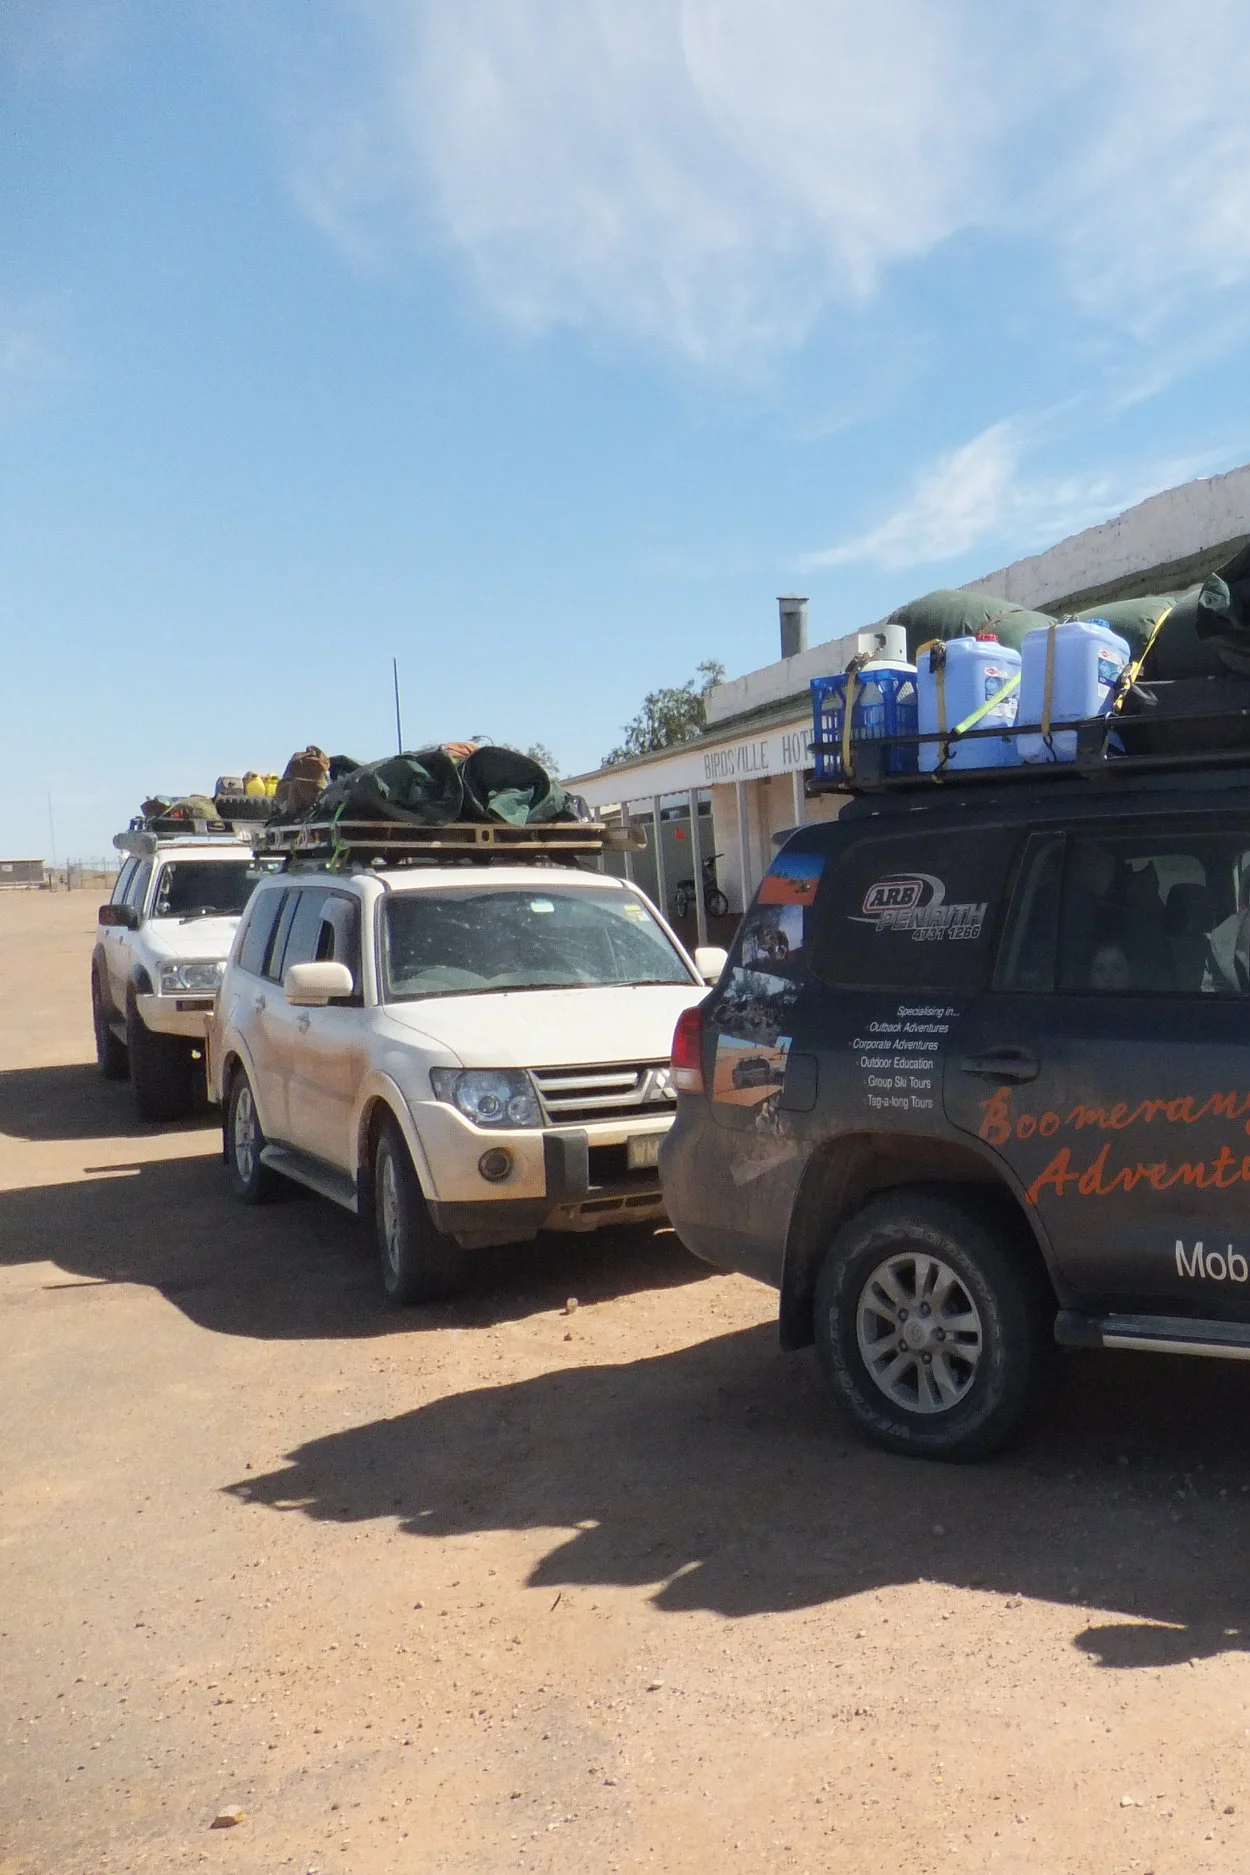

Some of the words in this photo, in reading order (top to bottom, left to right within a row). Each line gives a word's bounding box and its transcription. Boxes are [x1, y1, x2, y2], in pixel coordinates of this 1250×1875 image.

[703, 741, 769, 780] BIRDSVILLE
[782, 728, 814, 765] HOT
[870, 887, 915, 906] ARB
[875, 902, 988, 931] PENRITH
[949, 925, 981, 939] 1266
[897, 1006, 944, 1018] Specialising
[869, 1022, 901, 1032] Outback
[903, 1022, 949, 1033] Adventures
[852, 1038, 892, 1051] Corporate
[892, 1039, 939, 1051] Adventures
[860, 1056, 892, 1068] Outdoor
[893, 1056, 933, 1069] Education
[867, 1075, 893, 1090] Group
[894, 1075, 907, 1088] Ski
[908, 1076, 931, 1089] Tours
[867, 1094, 909, 1109] Tag-a-long
[910, 1095, 933, 1109] Tours
